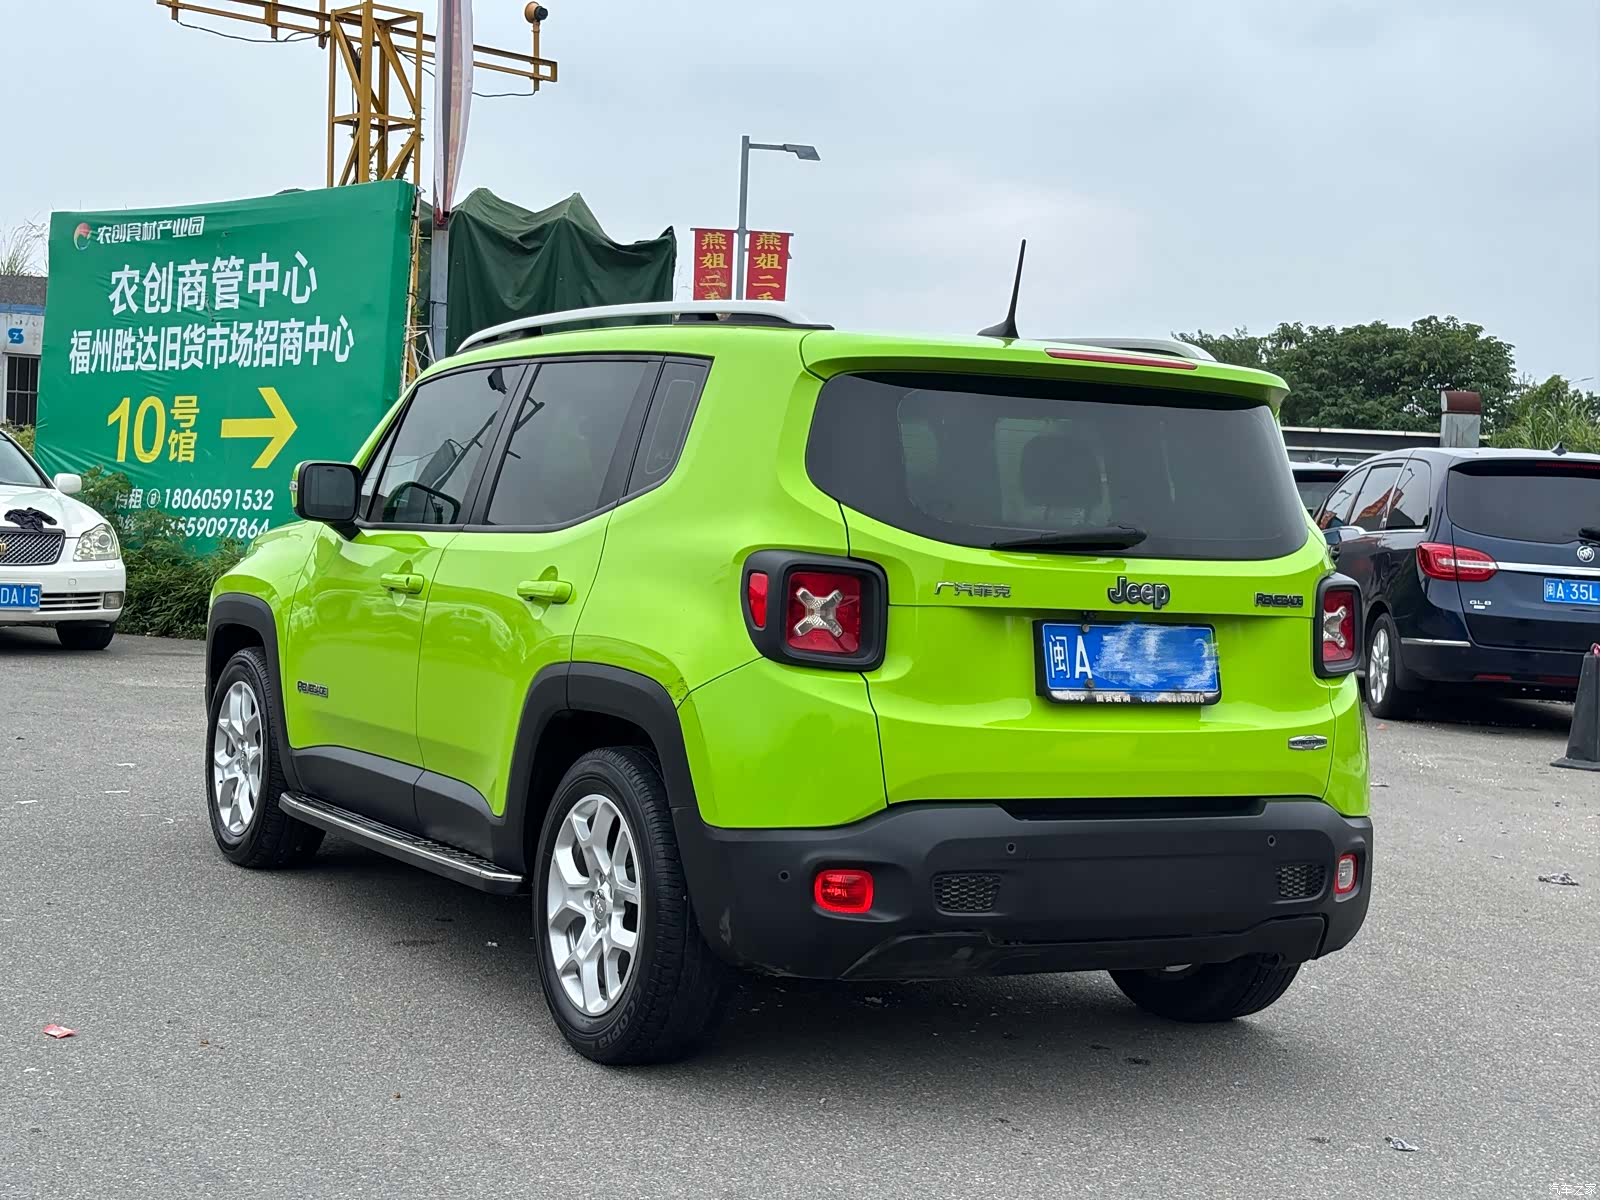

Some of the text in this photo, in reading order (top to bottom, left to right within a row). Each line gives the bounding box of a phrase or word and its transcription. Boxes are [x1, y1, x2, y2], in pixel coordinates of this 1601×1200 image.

[97, 216, 205, 245] 农创食材产业园
[108, 251, 318, 316] 农创商管中心
[69, 314, 355, 375] 福州胜达旧货市场招商中心
[163, 488, 275, 511] 18060591532
[0, 587, 39, 604] DA15
[934, 581, 1012, 599] 广汽菲克
[1107, 575, 1171, 610] Jeep
[1049, 634, 1093, 679] 闽A
